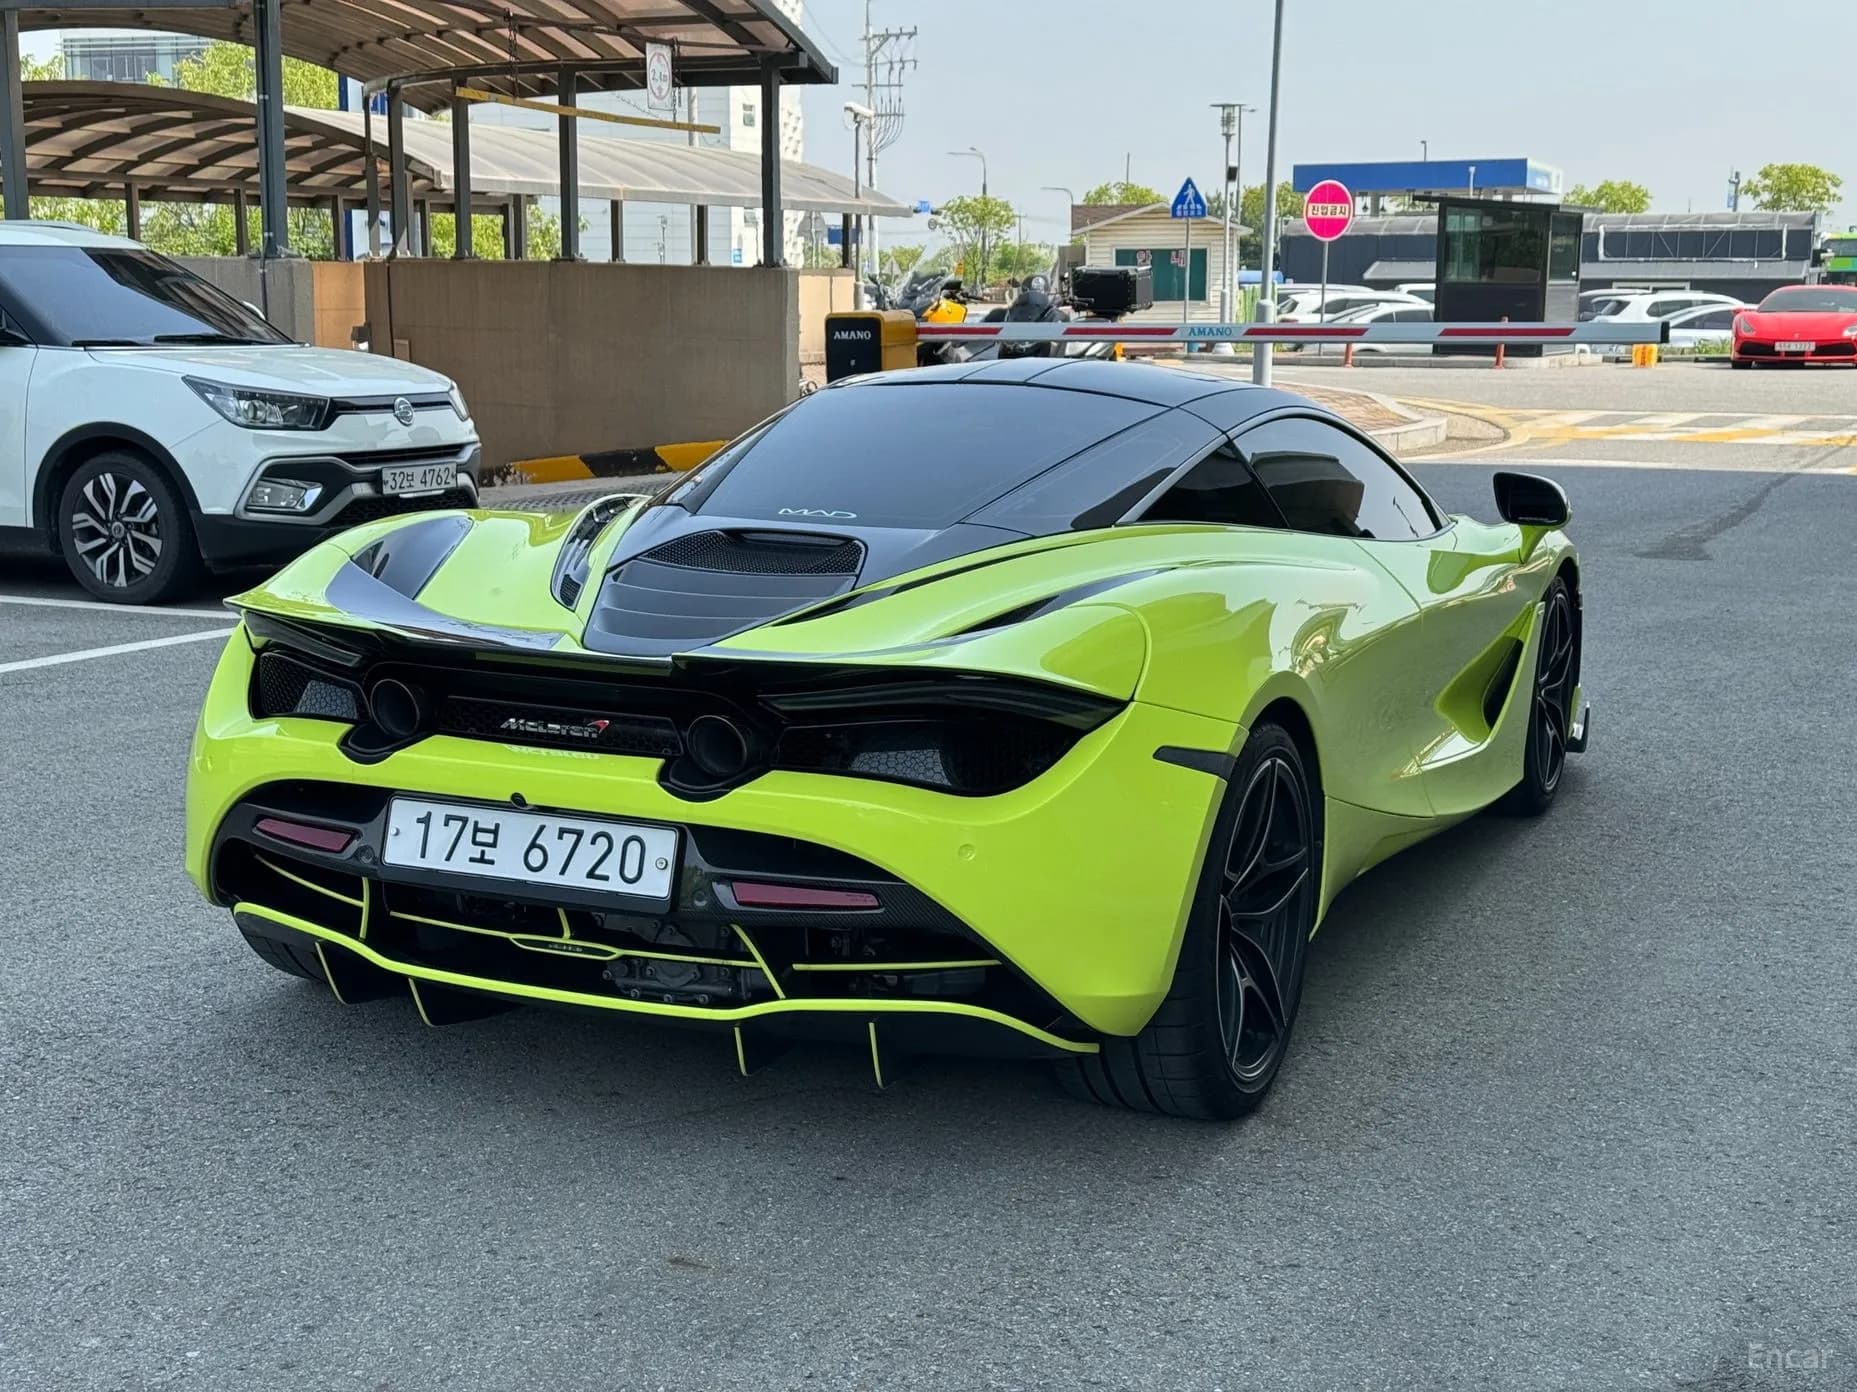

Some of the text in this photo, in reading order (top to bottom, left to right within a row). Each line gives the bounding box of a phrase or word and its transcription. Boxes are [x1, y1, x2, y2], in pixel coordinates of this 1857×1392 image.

[1311, 204, 1347, 216] 진입금지
[833, 330, 872, 340] AMANO
[1189, 326, 1232, 336] AMANO
[390, 467, 450, 490] 32보 4762
[778, 508, 857, 519] MAD
[500, 718, 599, 738] McLaren
[415, 811, 647, 884] 17보 6720
